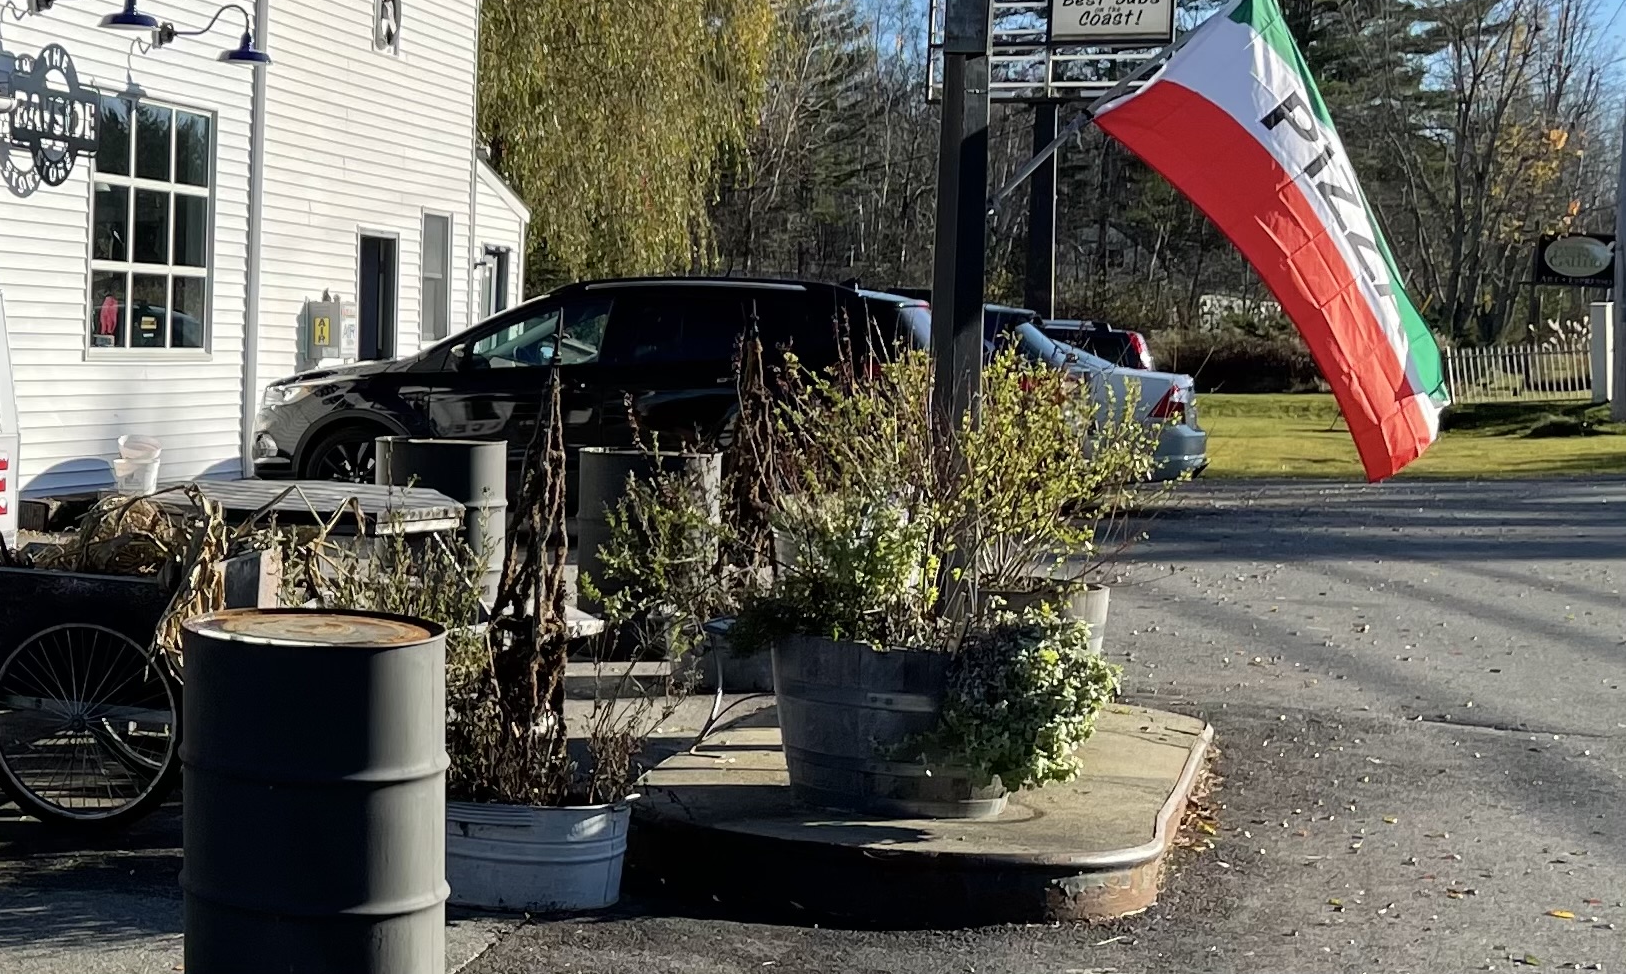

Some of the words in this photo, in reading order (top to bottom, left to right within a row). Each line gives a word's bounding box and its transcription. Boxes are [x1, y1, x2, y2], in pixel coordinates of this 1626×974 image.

[1079, 9, 1143, 26] Coast!
[1260, 91, 1406, 346] PIZZ
[318, 318, 326, 343] AIR
